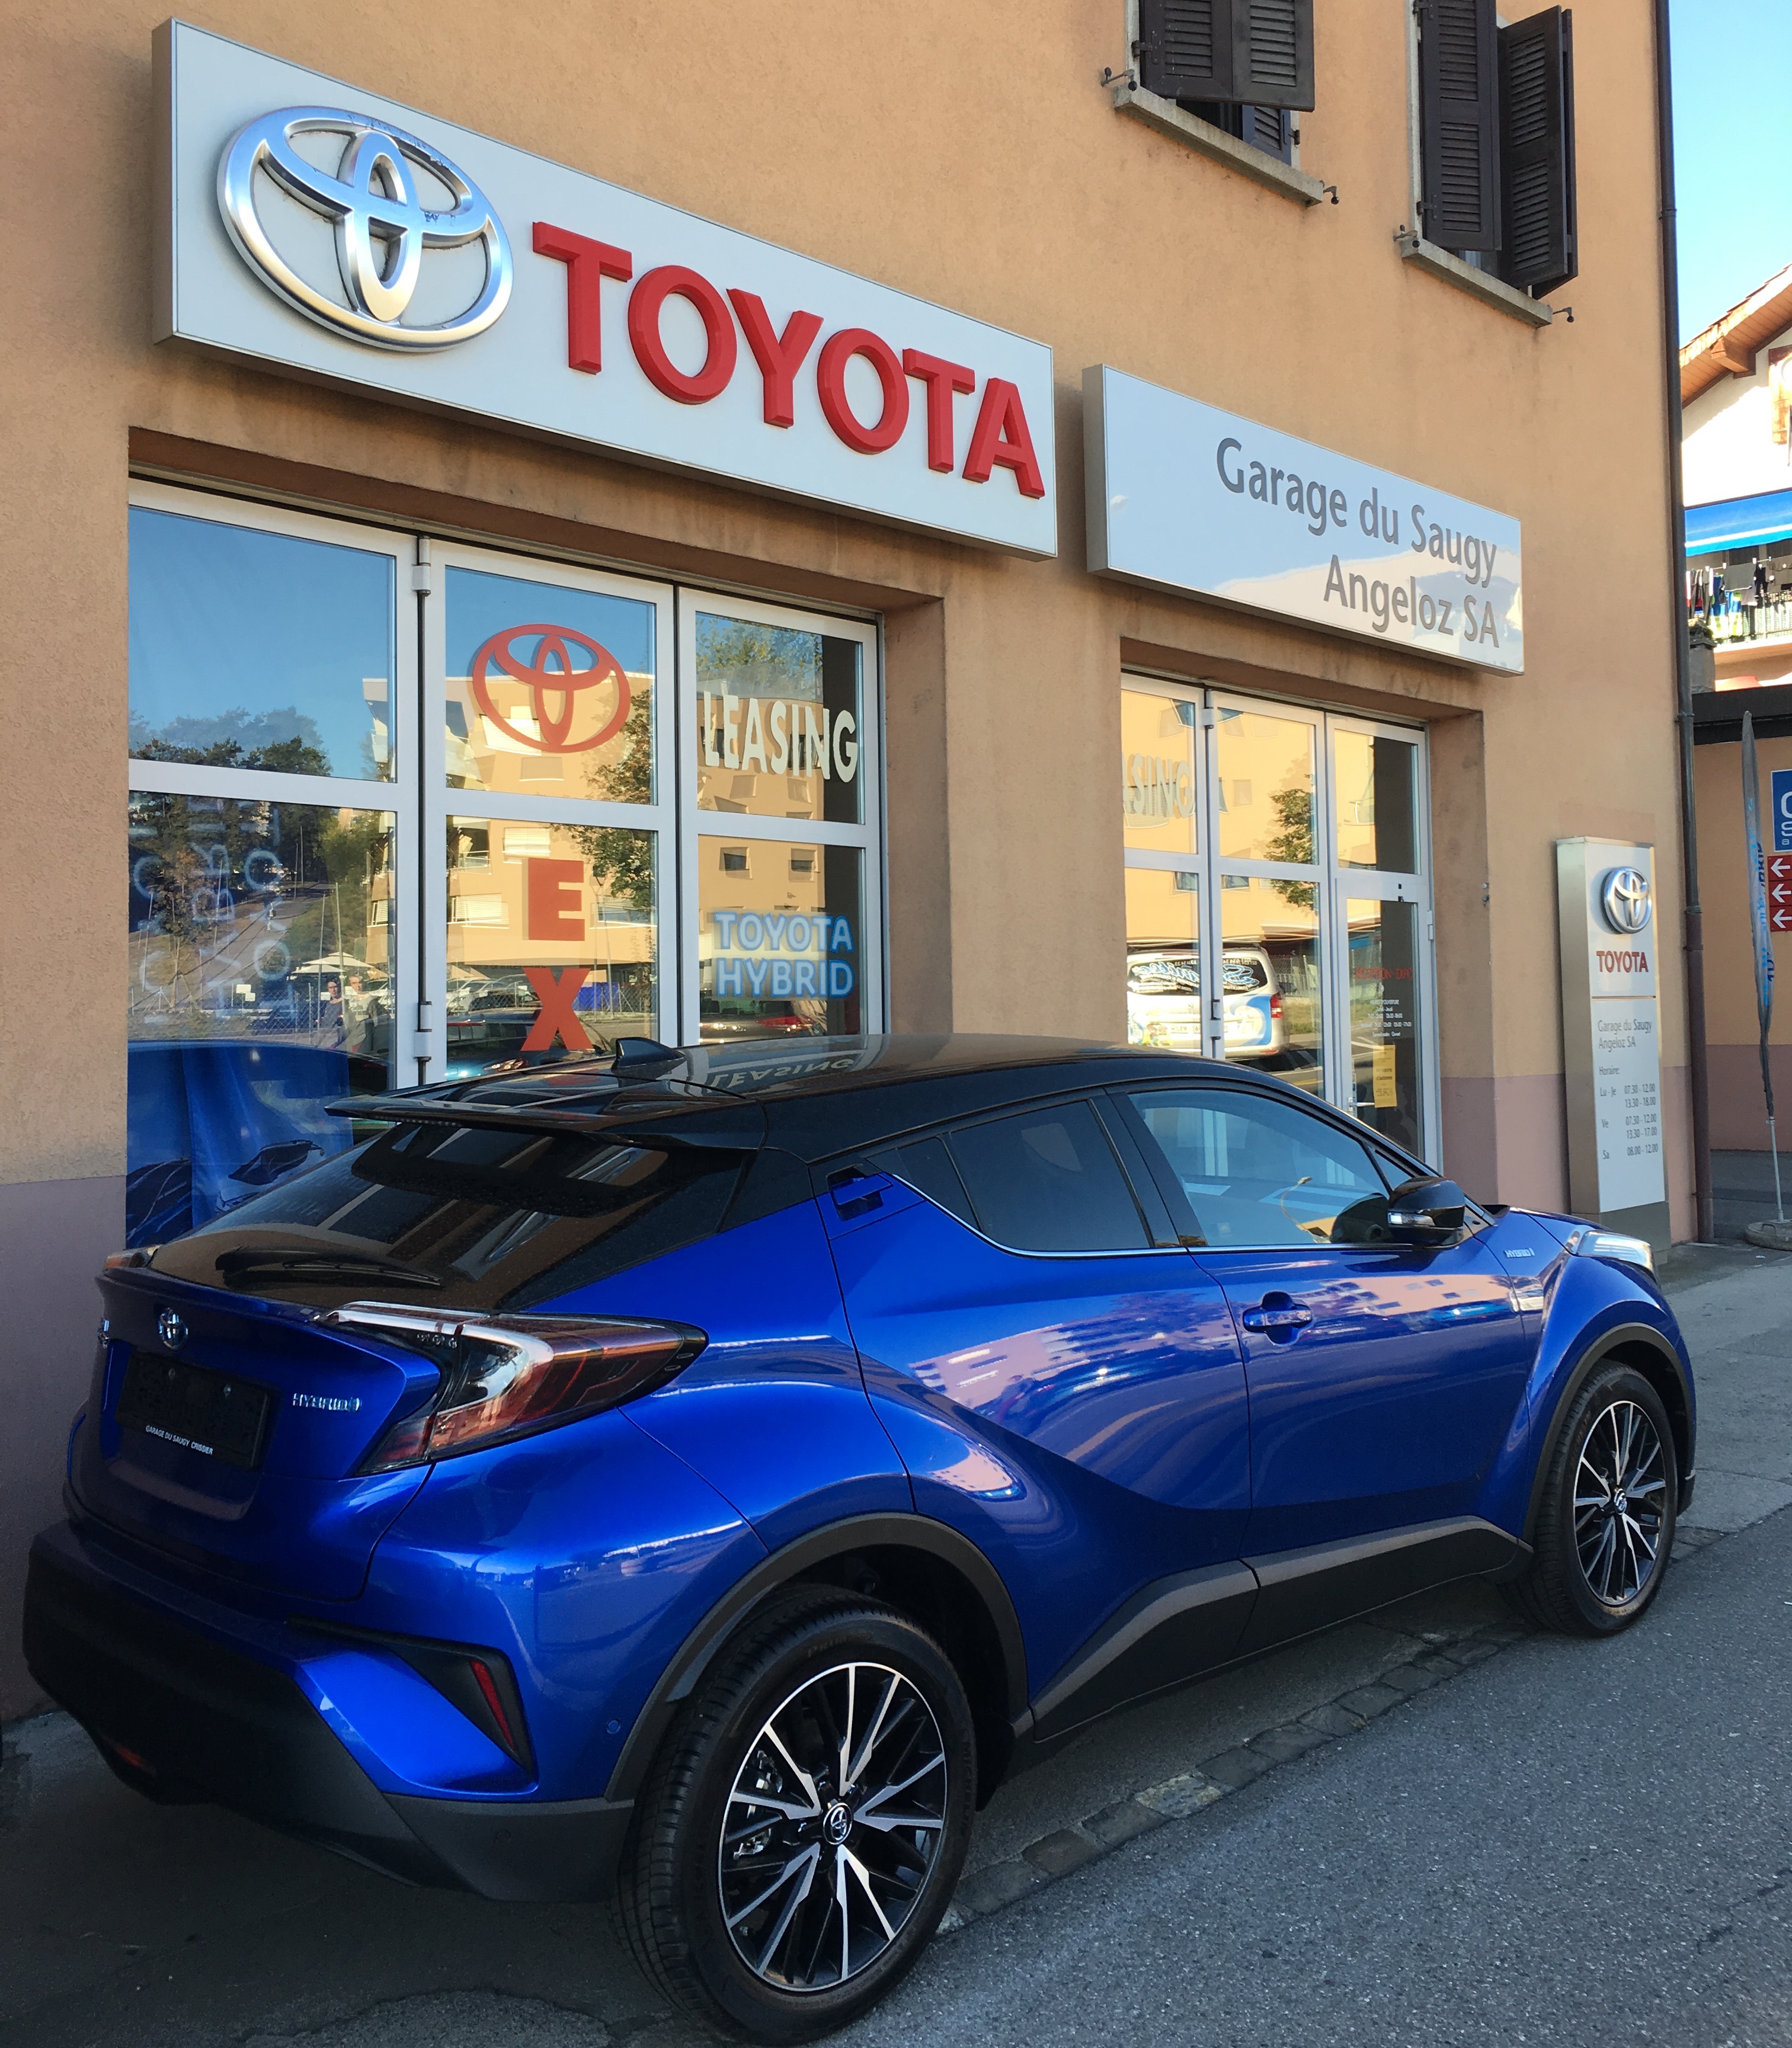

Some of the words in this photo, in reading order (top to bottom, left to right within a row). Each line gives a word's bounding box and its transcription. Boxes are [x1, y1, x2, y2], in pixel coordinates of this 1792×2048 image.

[532, 221, 1045, 499] TOYOTA
[1216, 437, 1348, 536] Garage
[1359, 487, 1399, 545] du
[1411, 504, 1497, 588] Saugy
[1323, 554, 1455, 633] Angeloz
[1463, 594, 1500, 648] SA
[703, 690, 858, 783] LEASING
[1122, 752, 1194, 819] SING
[714, 911, 855, 953] TOYOTA
[1596, 950, 1649, 973] TOYOTA
[716, 958, 855, 999] HYBRID
[1598, 1019, 1622, 1035] Garage
[1623, 1019, 1632, 1031] du
[1633, 1019, 1652, 1033] Saugy
[1598, 1036, 1625, 1052] Angeloz
[1627, 1035, 1636, 1048] SA
[1600, 1087, 1607, 1096] Lu
[1624, 1084, 1638, 1095] 07.30
[1642, 1083, 1655, 1093] 12.00
[1625, 1098, 1639, 1108] 13.30
[1643, 1096, 1656, 1106] 18.00
[1601, 1119, 1609, 1128] Ve
[1625, 1115, 1640, 1126] 07.30
[1643, 1113, 1657, 1123] 12.00
[1626, 1129, 1640, 1139] 13.30
[1644, 1127, 1657, 1137] 17.00
[1603, 1150, 1610, 1160] Sa
[1645, 1143, 1658, 1153] 12.00
[145, 1424, 165, 1438] GARAGE
[164, 1432, 173, 1441] DU
[172, 1435, 190, 1447] SAUGY
